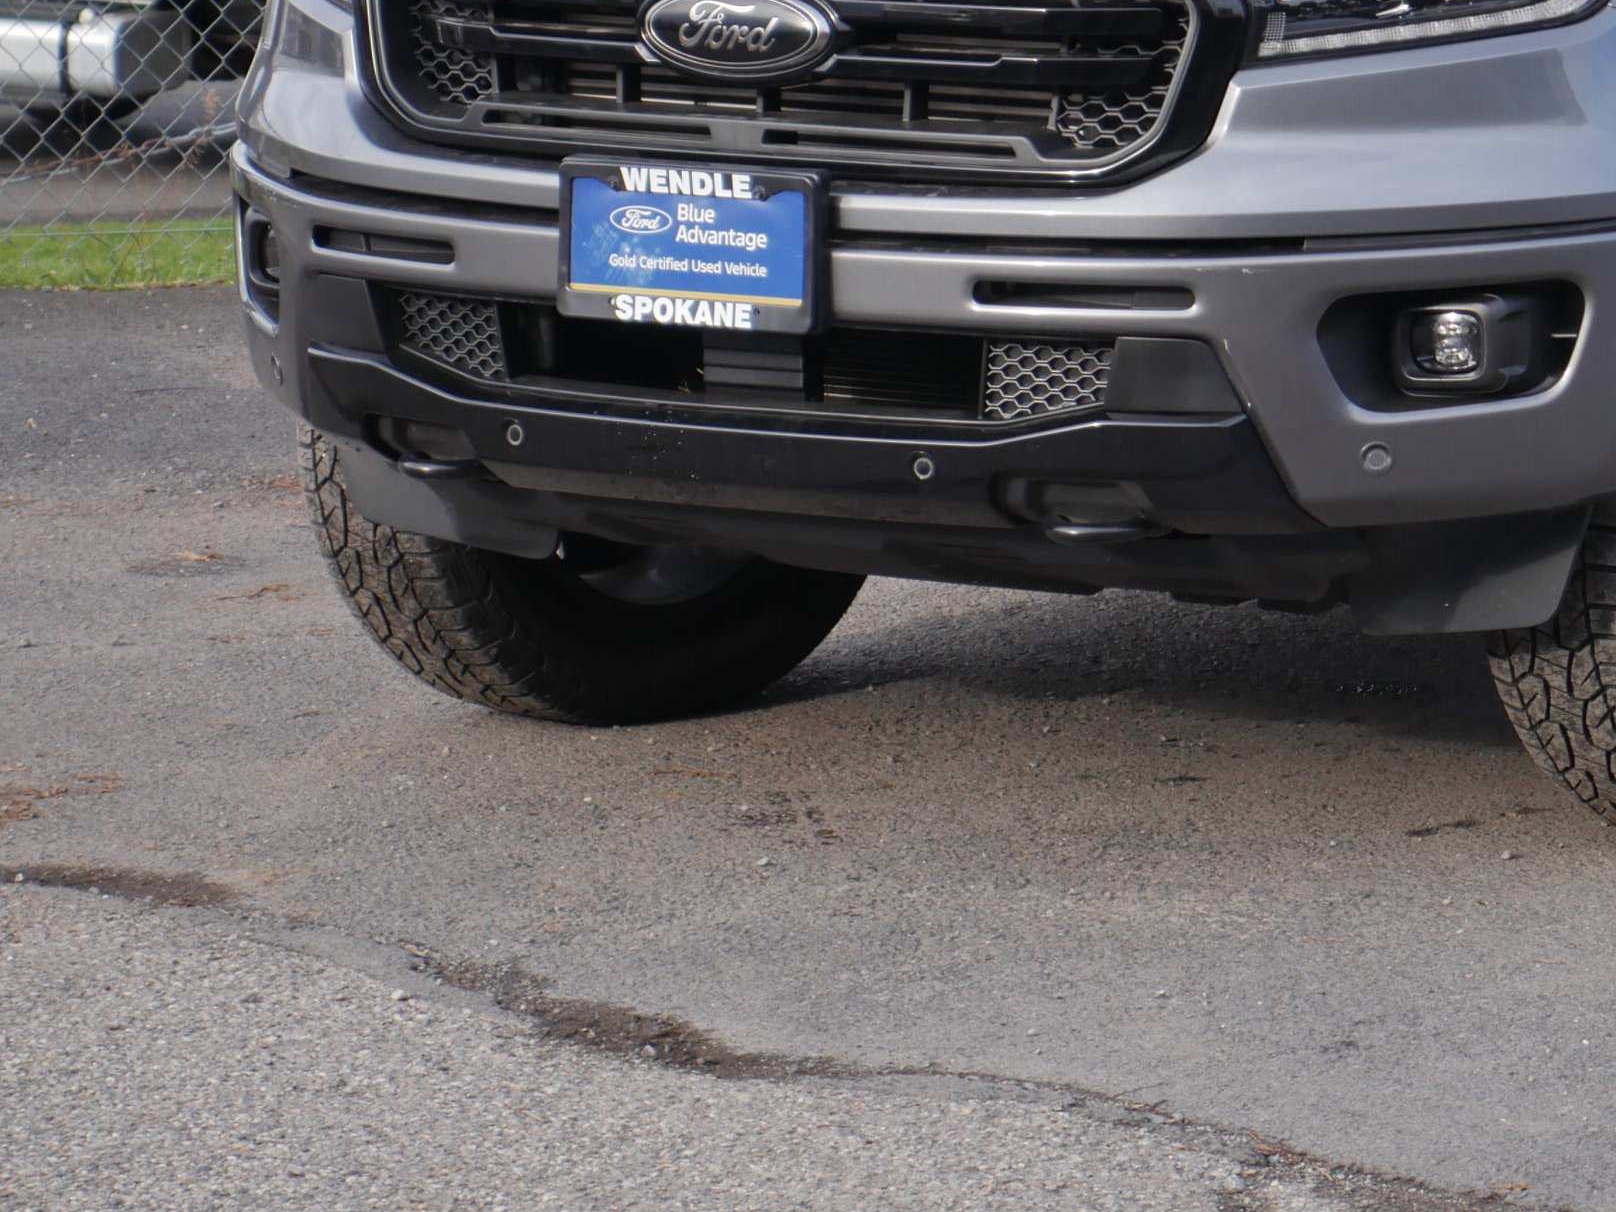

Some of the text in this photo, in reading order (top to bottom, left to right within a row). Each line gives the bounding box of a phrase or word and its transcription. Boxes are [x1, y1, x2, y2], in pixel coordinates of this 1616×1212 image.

[678, 0, 779, 53] Ford
[619, 166, 752, 200] WENDLE
[620, 208, 662, 231] Ford
[676, 203, 716, 224] Blue
[675, 224, 768, 252] Advantage
[608, 253, 768, 278] Gold Certified Used Vehicle
[614, 294, 752, 329] SPOKANE
